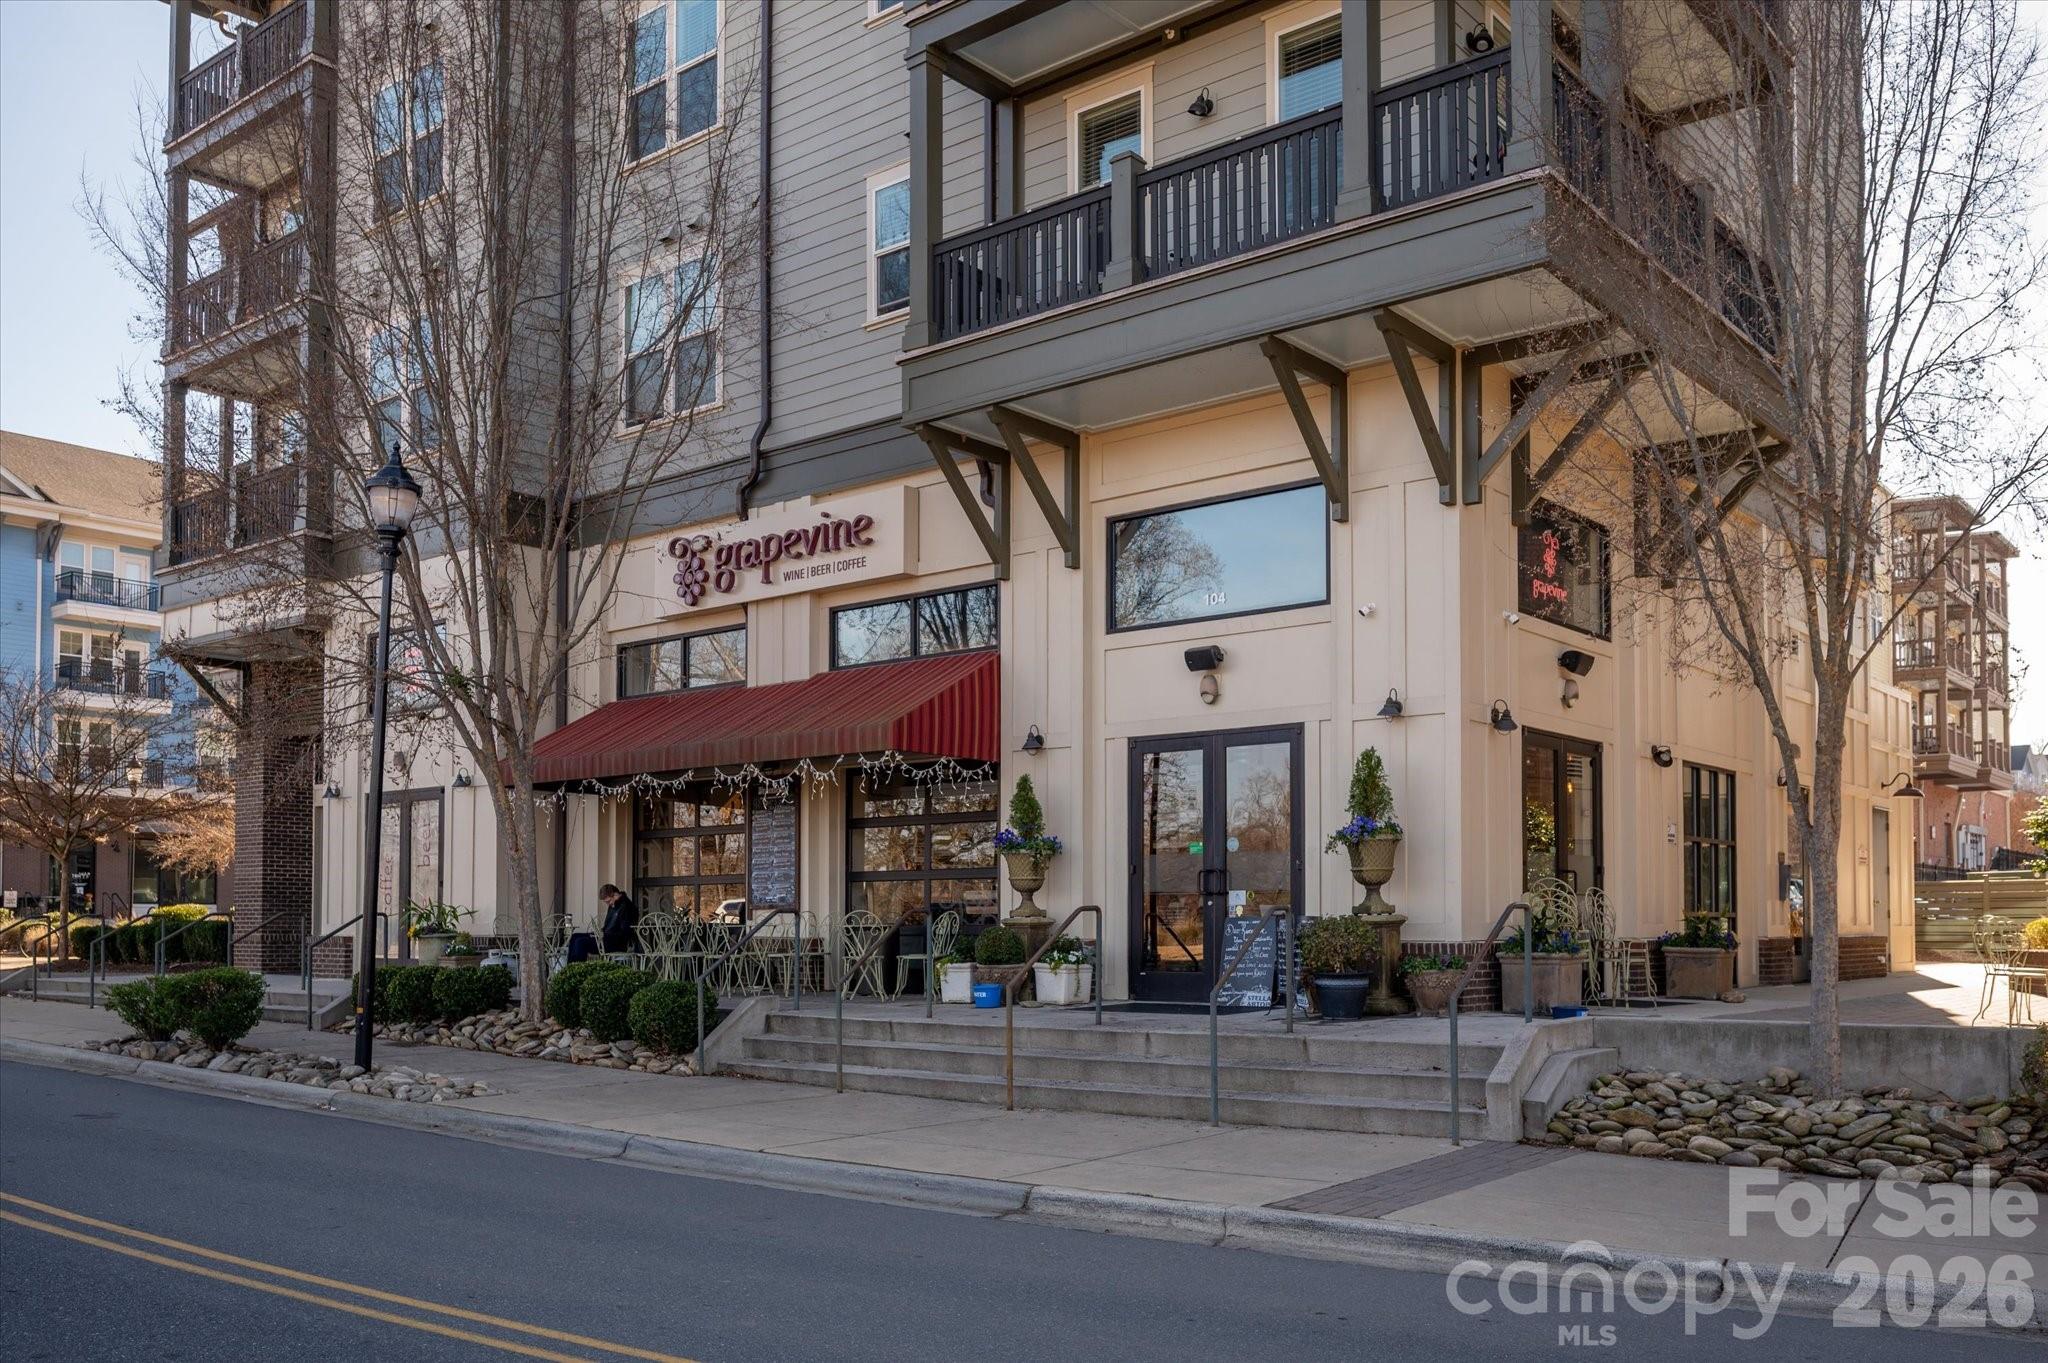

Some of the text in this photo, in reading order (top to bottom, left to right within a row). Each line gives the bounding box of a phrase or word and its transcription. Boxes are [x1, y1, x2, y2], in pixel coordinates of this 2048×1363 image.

[714, 511, 875, 593] grapevine
[783, 556, 867, 582] WINE BEER COFFEE
[1203, 592, 1226, 606] 104
